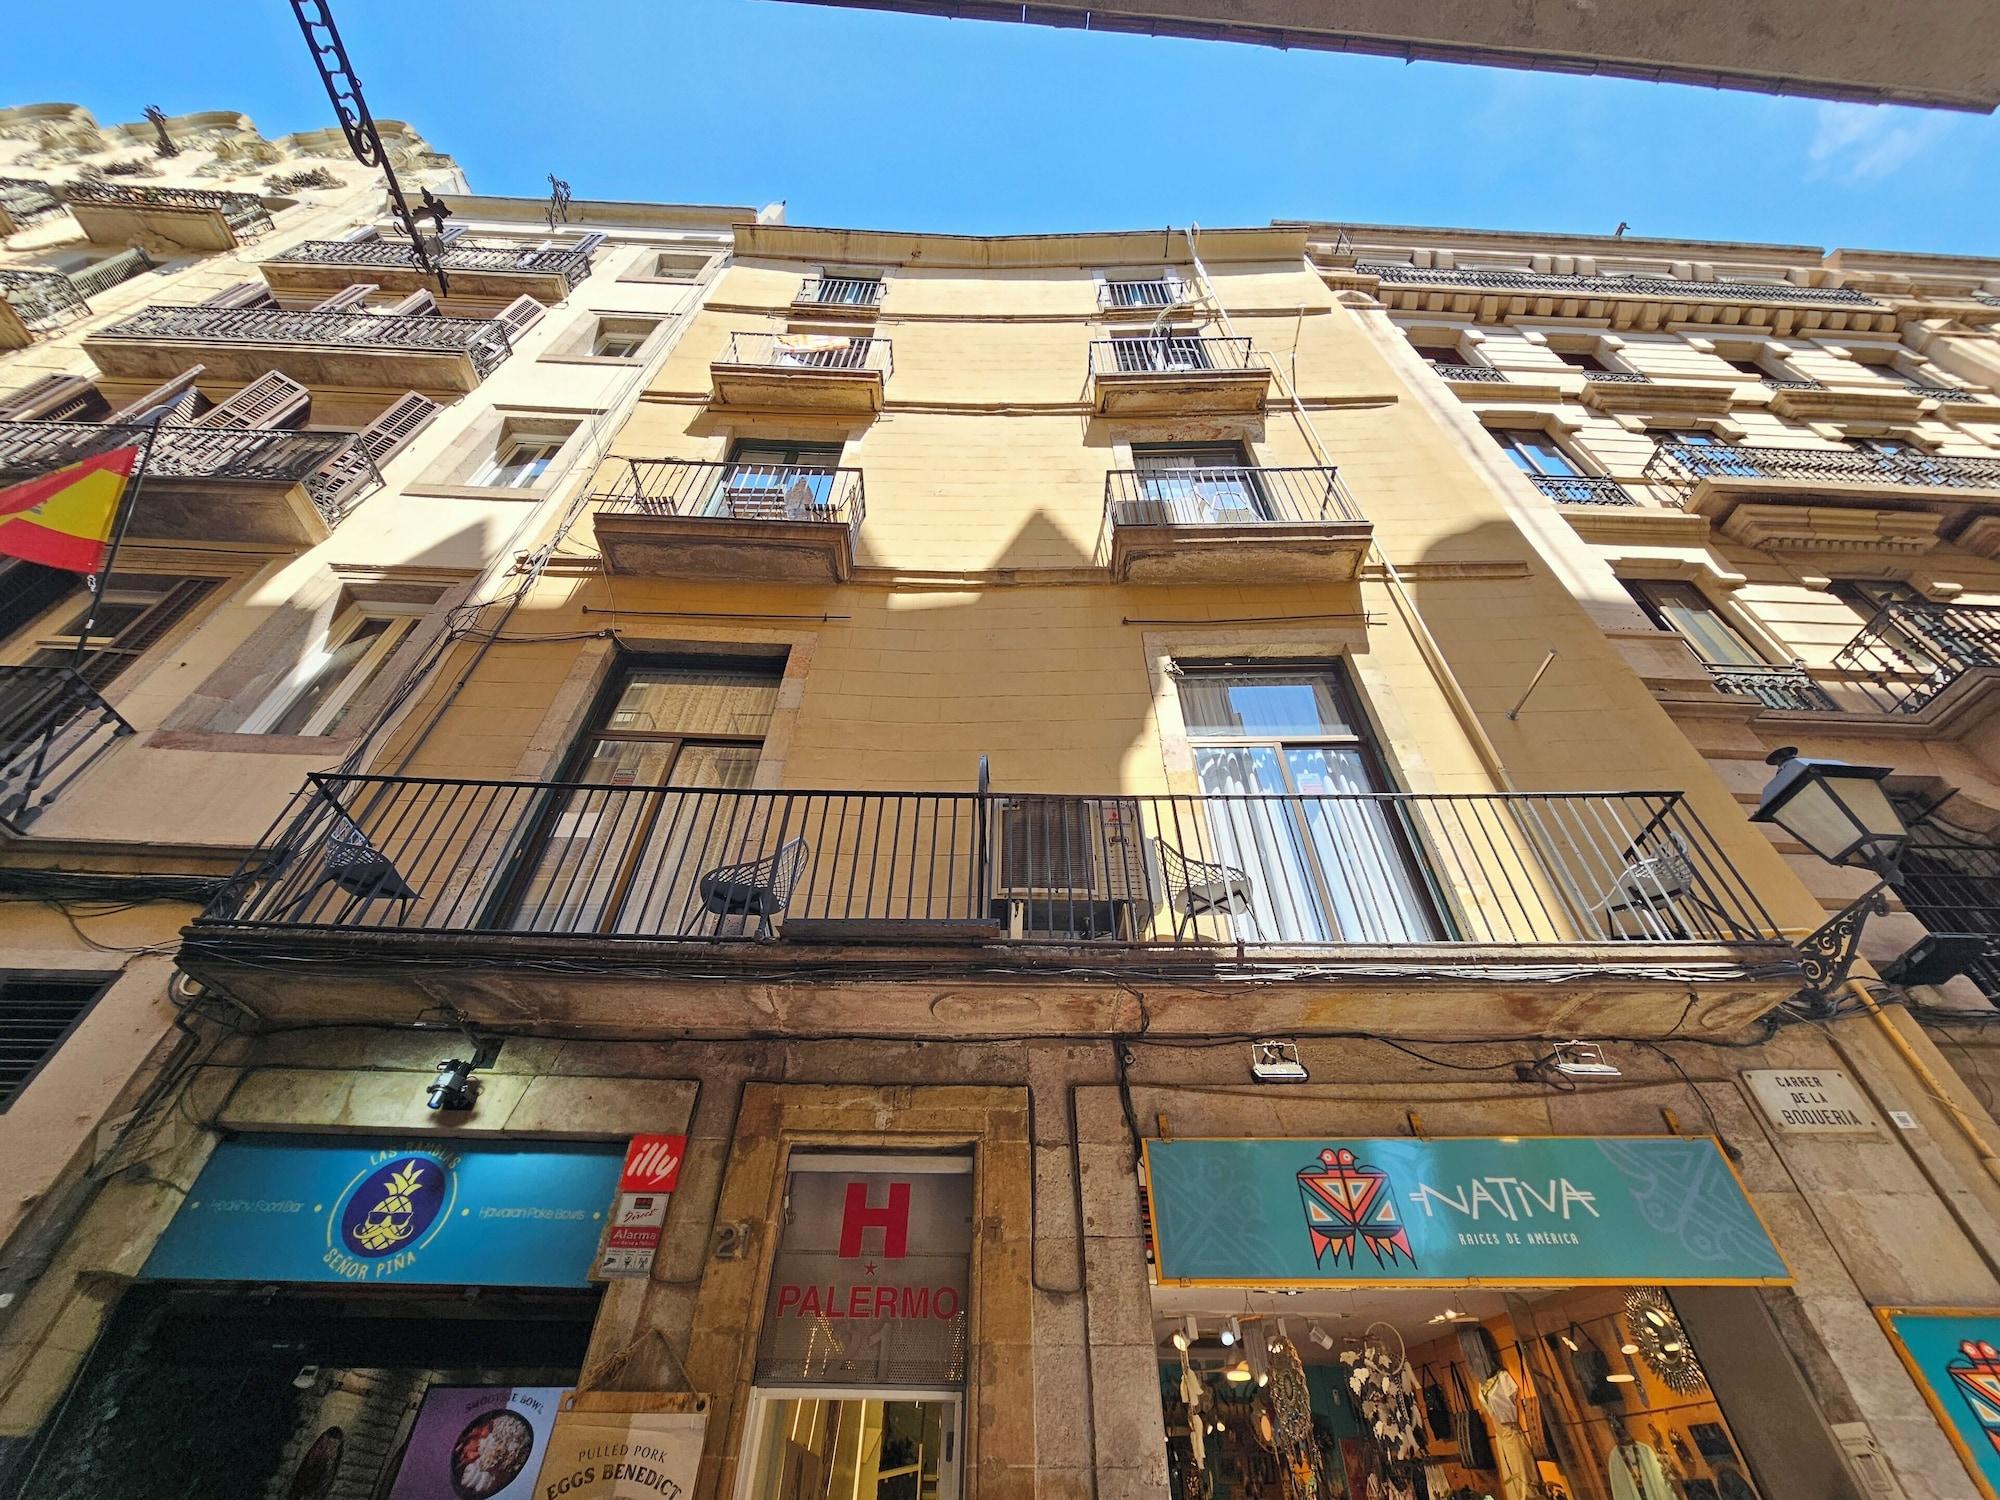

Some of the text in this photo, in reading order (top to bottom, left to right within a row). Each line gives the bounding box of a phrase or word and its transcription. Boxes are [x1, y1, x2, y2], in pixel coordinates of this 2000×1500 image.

[1775, 1076, 1824, 1088] CARRER
[1790, 1092, 1829, 1104] DE LA
[1781, 1109, 1864, 1126] BOQUERIA
[370, 1147, 398, 1166] LAS
[627, 1142, 679, 1185] illy
[1409, 1177, 1600, 1221] NATIVA
[839, 1182, 911, 1259] H
[613, 1229, 657, 1240] Alarma
[716, 1223, 751, 1258] 21
[1506, 1233, 1521, 1245] DE
[322, 1248, 416, 1281] SEÑOR PIÑA
[775, 1285, 959, 1319] PALERMO
[520, 1394, 544, 1415] BOWL
[578, 1443, 668, 1463] PULLED PORK
[546, 1463, 682, 1500] EGGS BENEDICT
